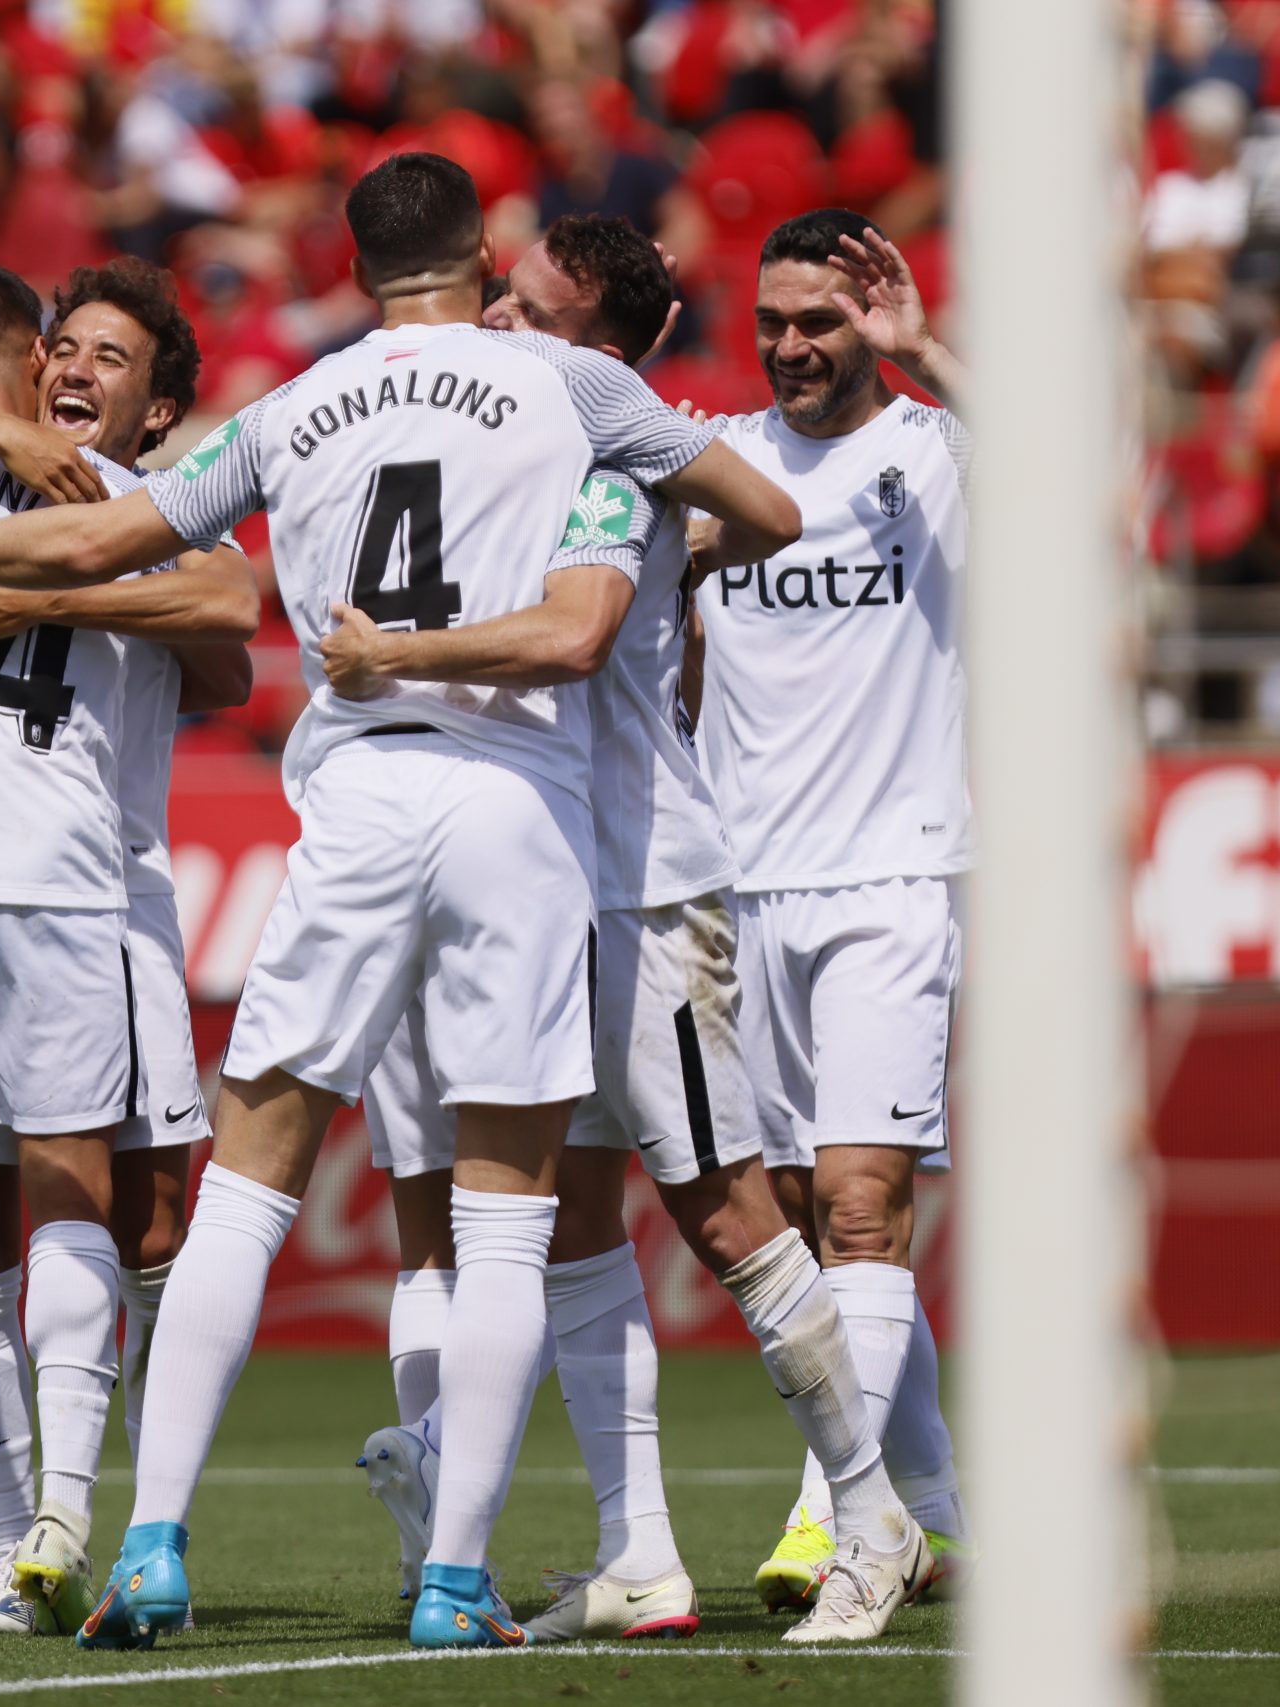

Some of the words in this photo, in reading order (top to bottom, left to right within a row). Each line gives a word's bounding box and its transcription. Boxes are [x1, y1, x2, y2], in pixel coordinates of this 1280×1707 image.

[289, 368, 519, 461] GONALONS
[344, 458, 463, 633] 4
[721, 544, 904, 609] Platzi
